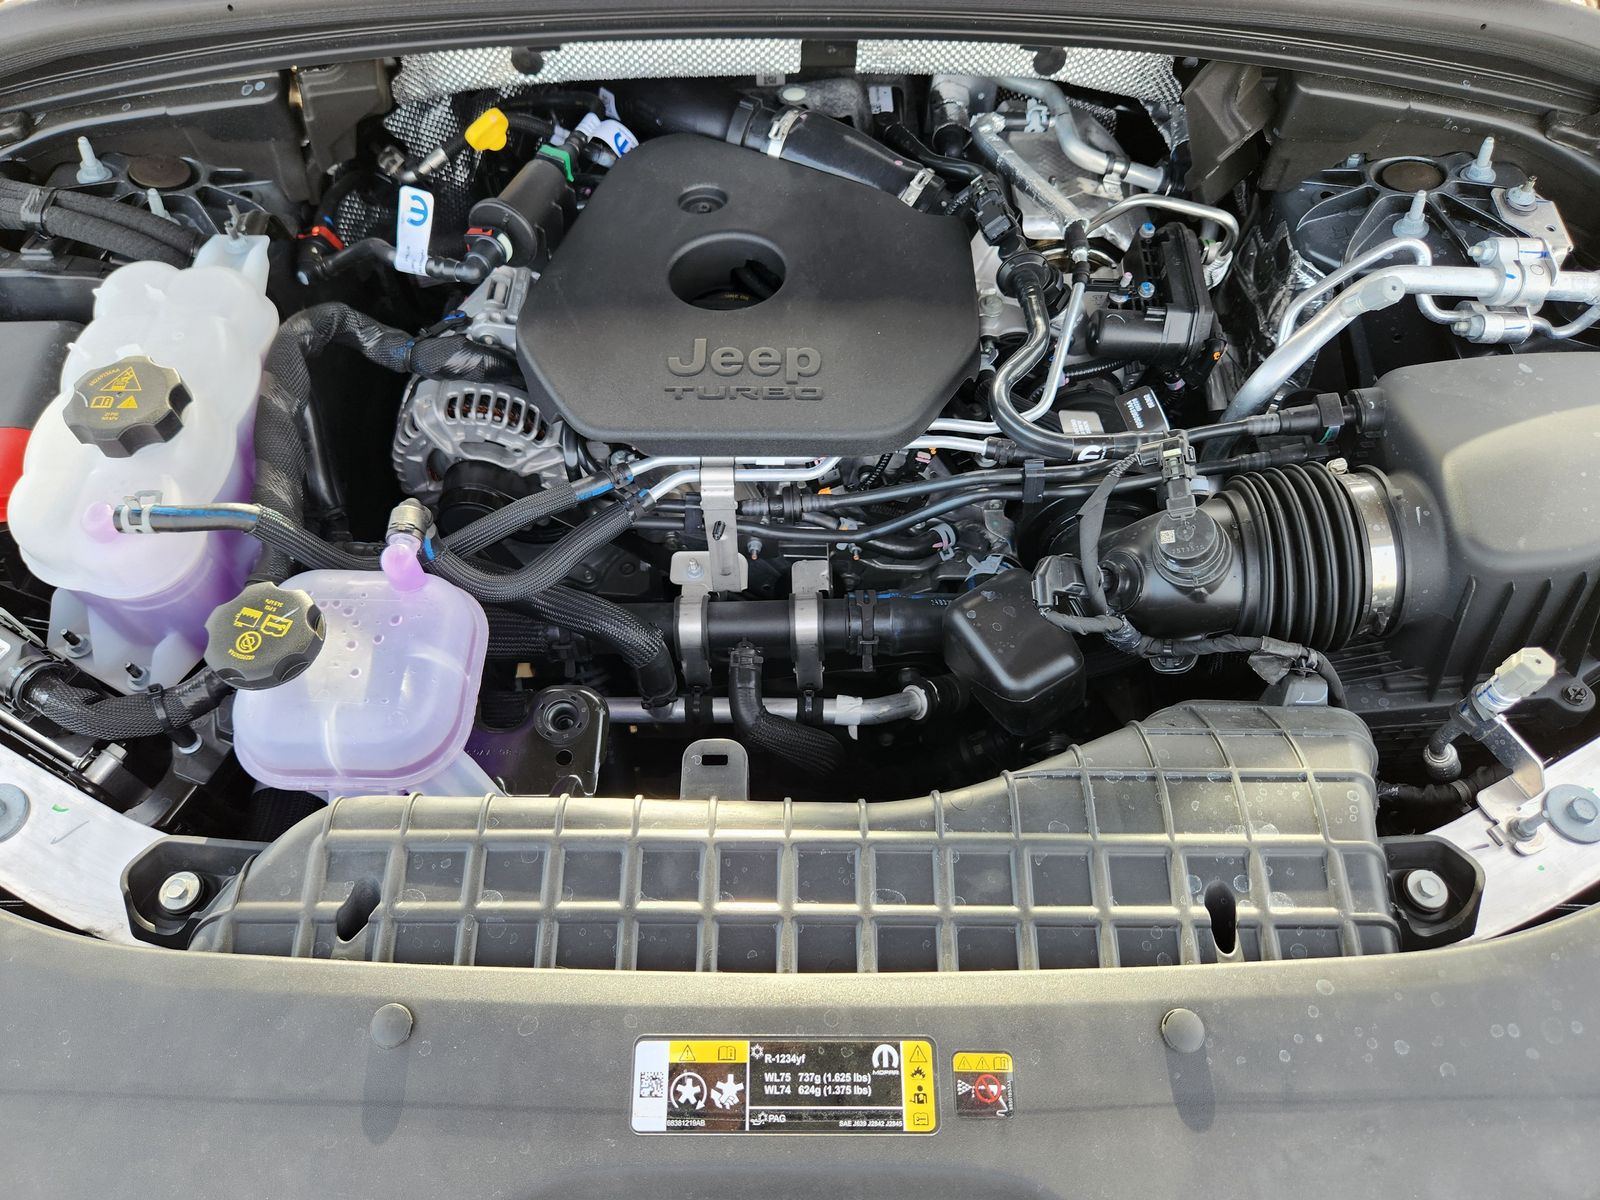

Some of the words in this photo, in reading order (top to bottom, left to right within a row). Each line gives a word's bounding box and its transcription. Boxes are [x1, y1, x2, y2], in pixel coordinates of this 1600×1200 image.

[667, 338, 822, 385] Jeep
[664, 386, 824, 400] TURBO
[764, 1053, 806, 1065] R-1234yf
[764, 1072, 792, 1083] WL75
[798, 1072, 822, 1085] 737g
[823, 1072, 851, 1084] (1.625
[853, 1072, 872, 1084] lbs)
[764, 1085, 792, 1095] WL74
[798, 1085, 822, 1097] 624g
[823, 1085, 851, 1096] (1.375
[853, 1085, 872, 1096] lbs)
[768, 1114, 786, 1123] PAG
